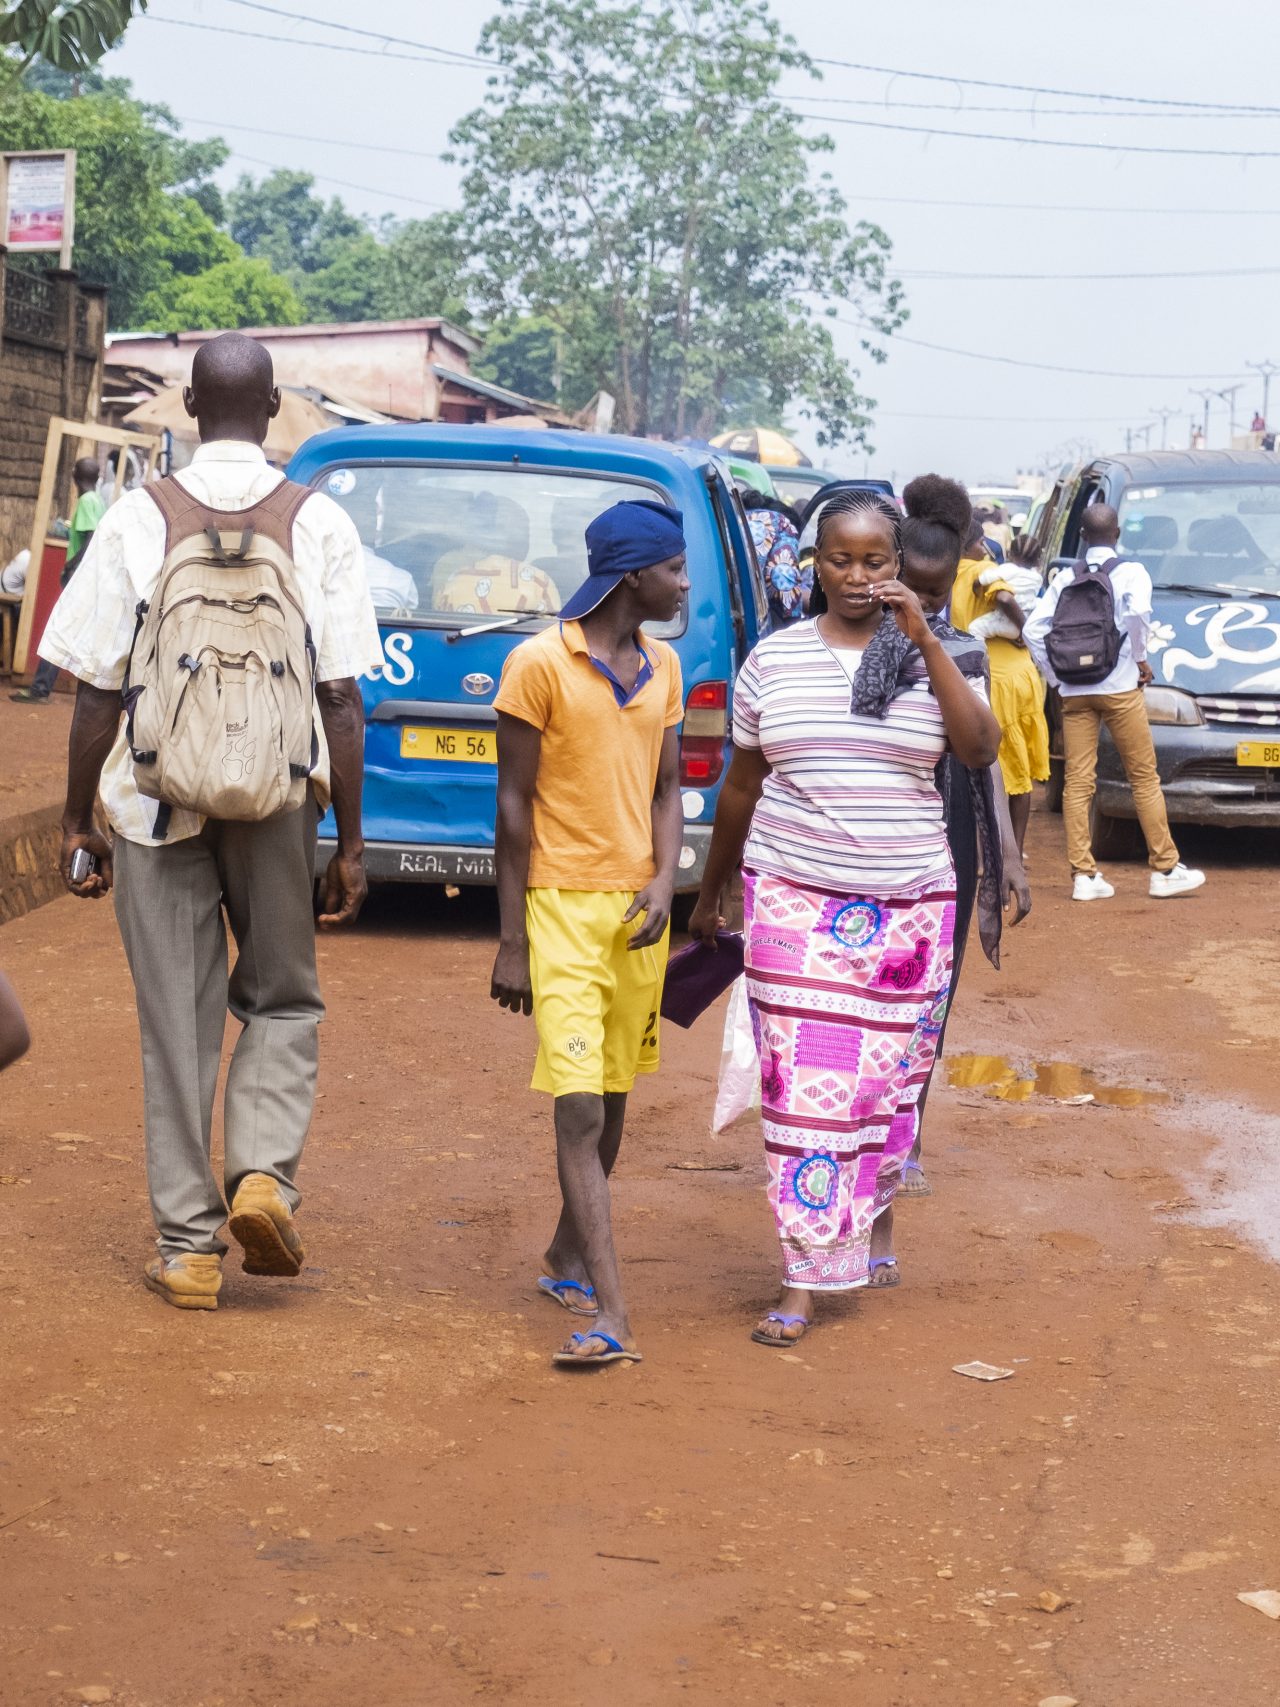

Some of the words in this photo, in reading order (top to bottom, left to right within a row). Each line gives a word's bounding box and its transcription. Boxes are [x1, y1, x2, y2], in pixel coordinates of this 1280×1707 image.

[435, 735, 456, 754] NG
[466, 737, 486, 756] 56
[1264, 747, 1279, 762] BG
[400, 853, 447, 873] REAL
[778, 939, 797, 953] MARS
[568, 1036, 586, 1052] BVB
[794, 1260, 815, 1271] MARS
